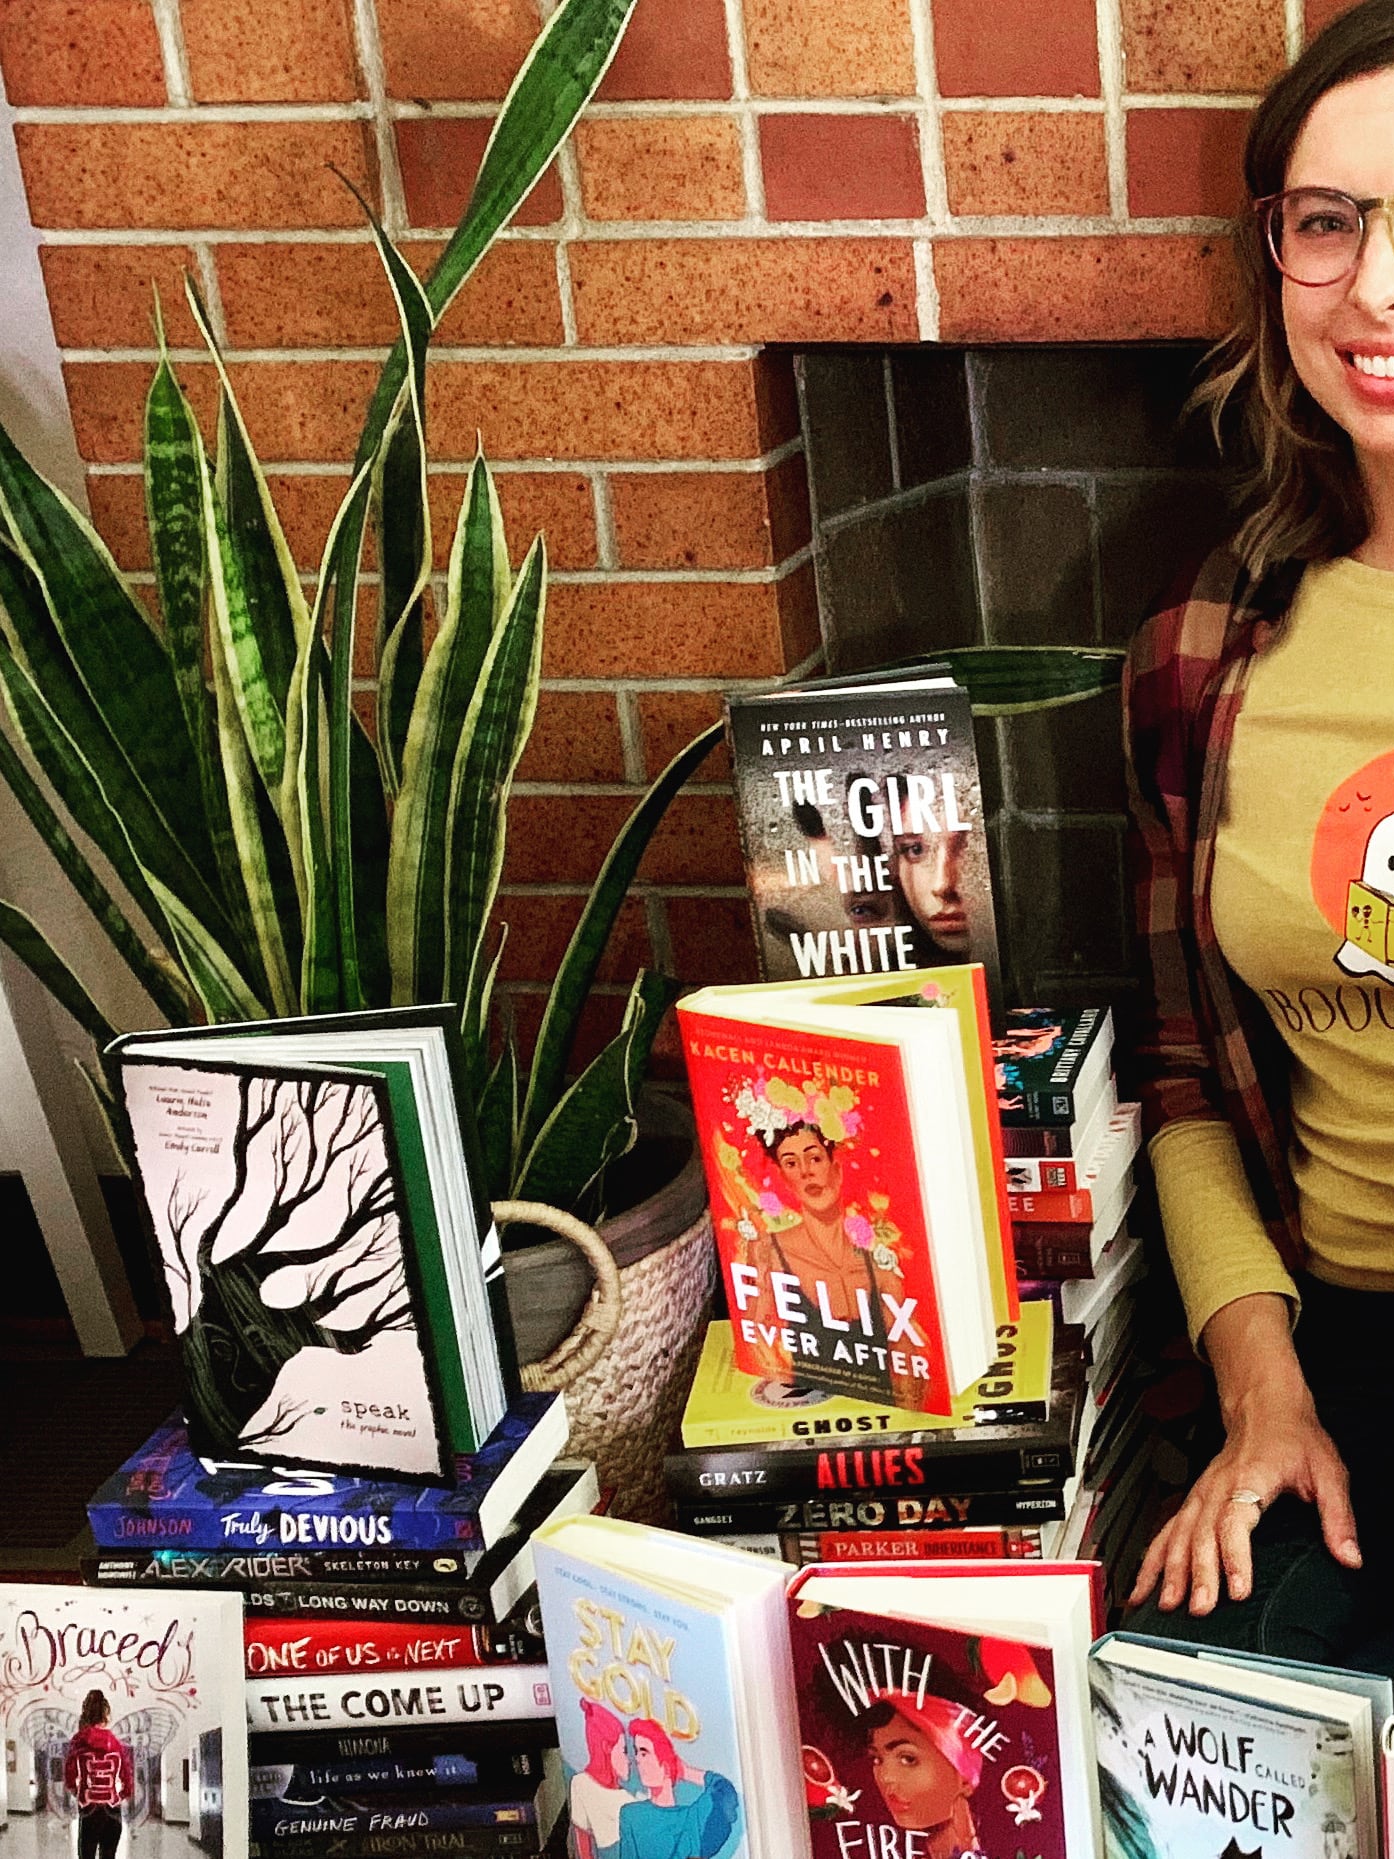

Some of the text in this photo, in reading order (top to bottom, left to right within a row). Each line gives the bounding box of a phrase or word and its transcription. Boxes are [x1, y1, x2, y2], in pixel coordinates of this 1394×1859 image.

[760, 723, 779, 732] NEW
[783, 722, 807, 731] YORK
[762, 728, 949, 756] APRIL HENRY
[773, 768, 972, 838] THE GIRL
[785, 849, 893, 894] IN THE
[790, 926, 918, 977] WHITE
[689, 1040, 756, 1064] KACEN
[763, 1053, 881, 1088] CALLENDER
[729, 1261, 927, 1349] FELIX
[740, 1319, 820, 1357] EVER
[833, 1340, 930, 1380] AFTER
[340, 1400, 411, 1421] speak
[792, 1414, 891, 1437] GHOST
[698, 1446, 925, 1490] GRATZ ALLIES
[113, 1512, 393, 1546] JOHNSON Truly DEVIOUS
[776, 1499, 885, 1529] ZERO
[898, 1498, 972, 1525] DAY
[140, 1556, 421, 1579] ALEX RIDER SKELETON KEY
[835, 1540, 997, 1557] PARKER INHERITANCE
[299, 1594, 450, 1614] LONG WAY DOWN
[5, 1610, 180, 1686] Braced
[247, 1636, 461, 1672] ONE OF US NEXT
[571, 1596, 676, 1684] STAY
[564, 1650, 700, 1742] GOLD
[818, 1639, 933, 1718] WITH
[260, 1682, 504, 1723] THE COME UP
[953, 1708, 1011, 1762] THE
[1144, 1728, 1156, 1748] A
[1164, 1712, 1255, 1774] WOLF
[1255, 1763, 1306, 1790] CALLED
[310, 1769, 338, 1785] life
[345, 1773, 361, 1783] as
[368, 1771, 389, 1781] we
[394, 1764, 438, 1780] knew
[1144, 1752, 1296, 1839] WANDER
[274, 1811, 429, 1837] GENUINE FRAUD
